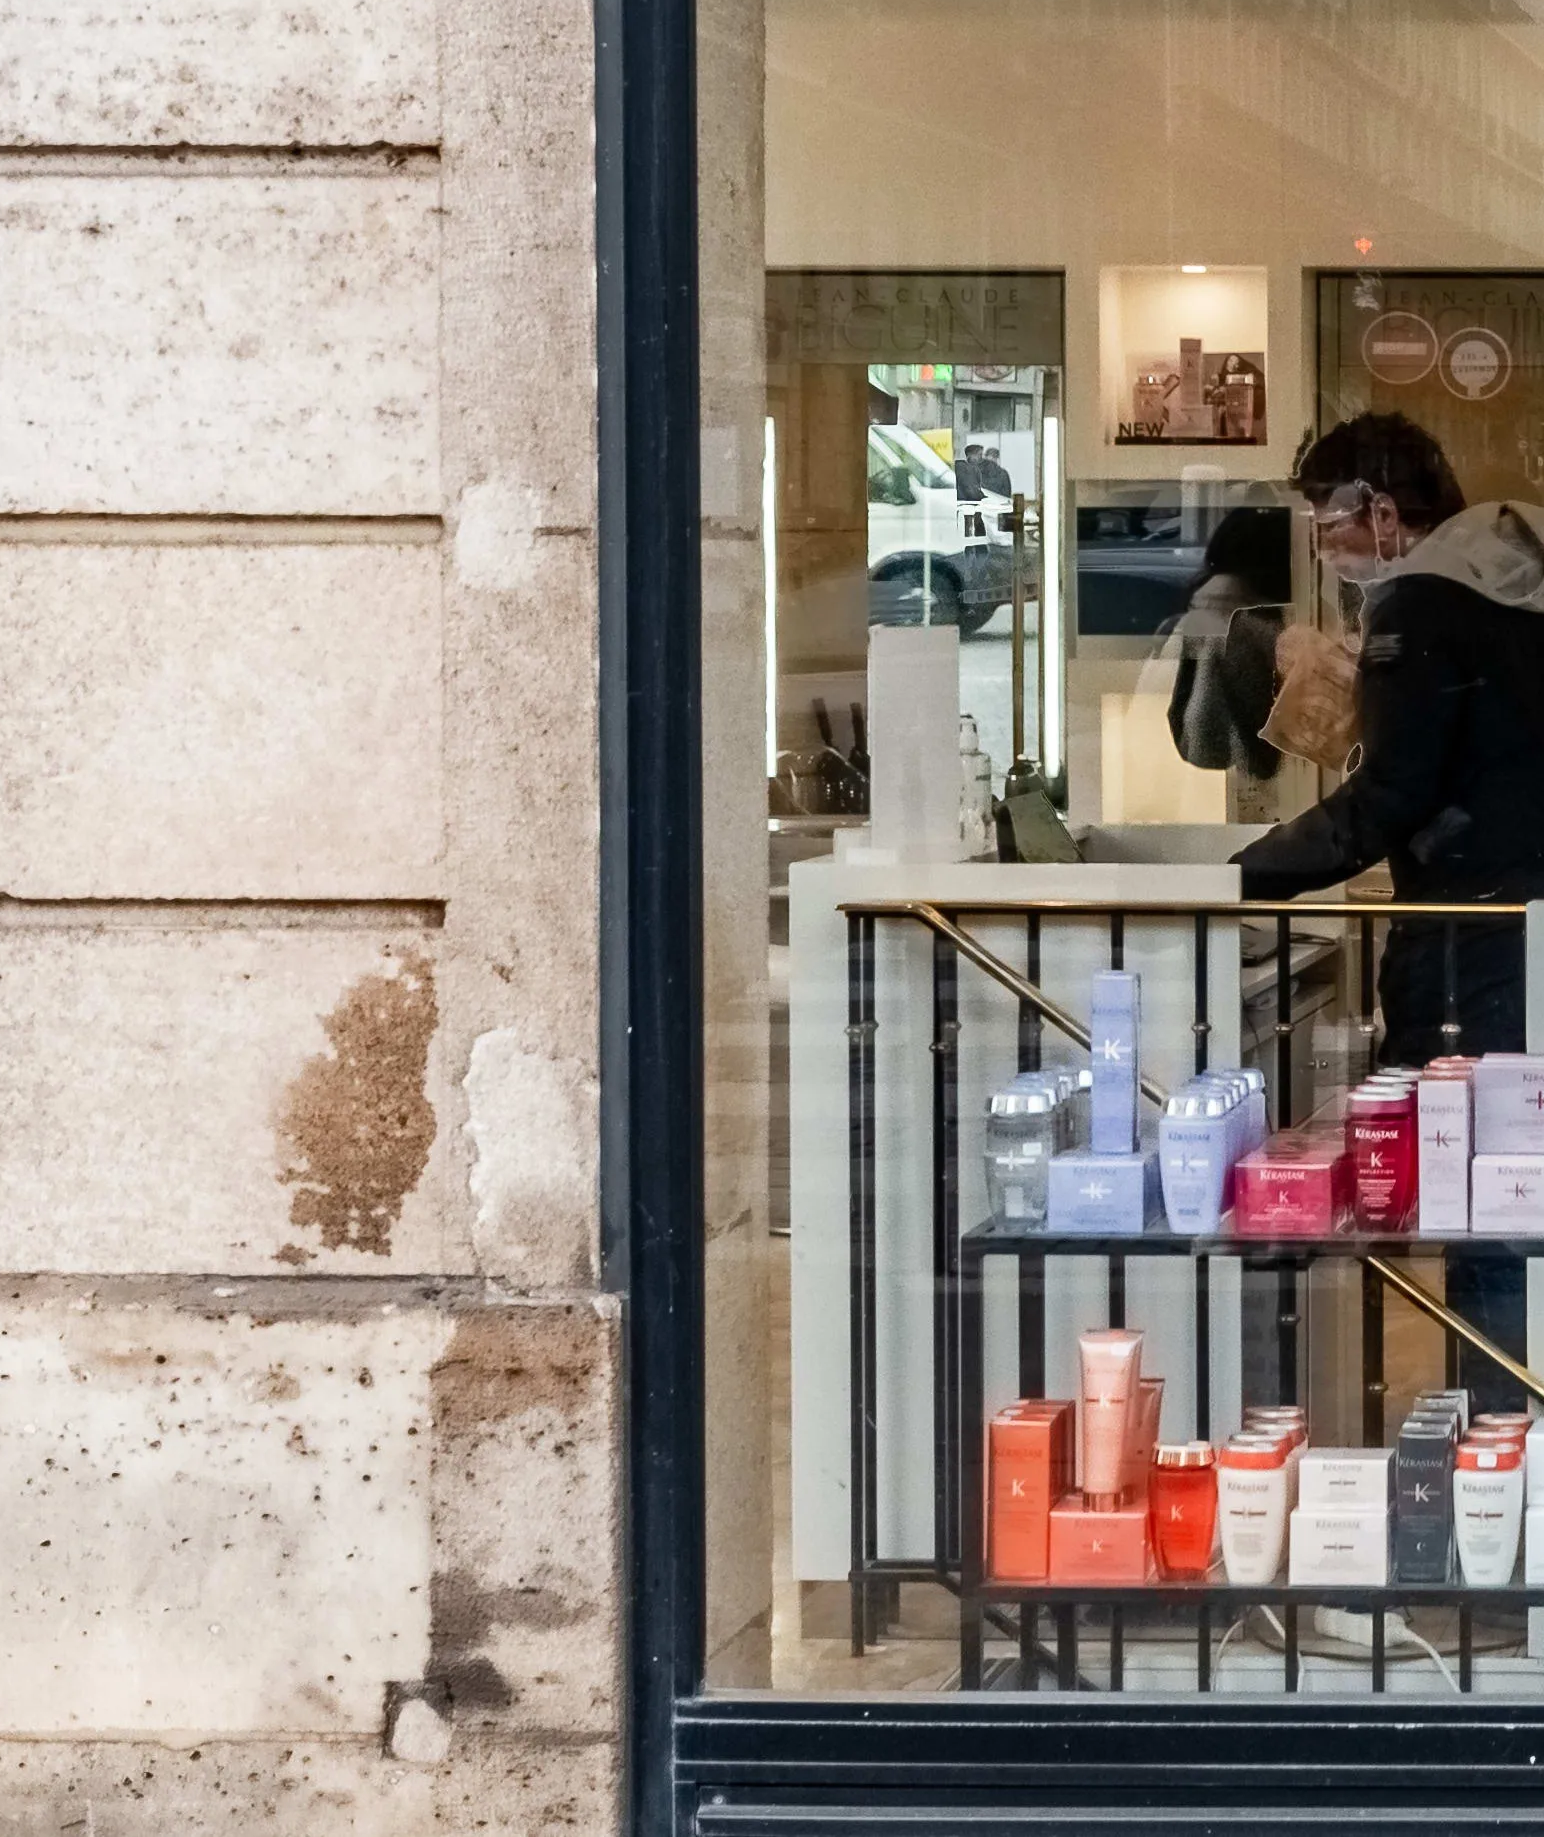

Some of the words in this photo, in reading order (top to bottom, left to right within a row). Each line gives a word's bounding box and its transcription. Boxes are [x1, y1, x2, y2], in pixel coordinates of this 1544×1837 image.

[1118, 422, 1165, 438] NEW
[1355, 1127, 1399, 1140] KÉRASTASE
[1371, 1151, 1384, 1168] K
[1414, 1482, 1430, 1503] K
